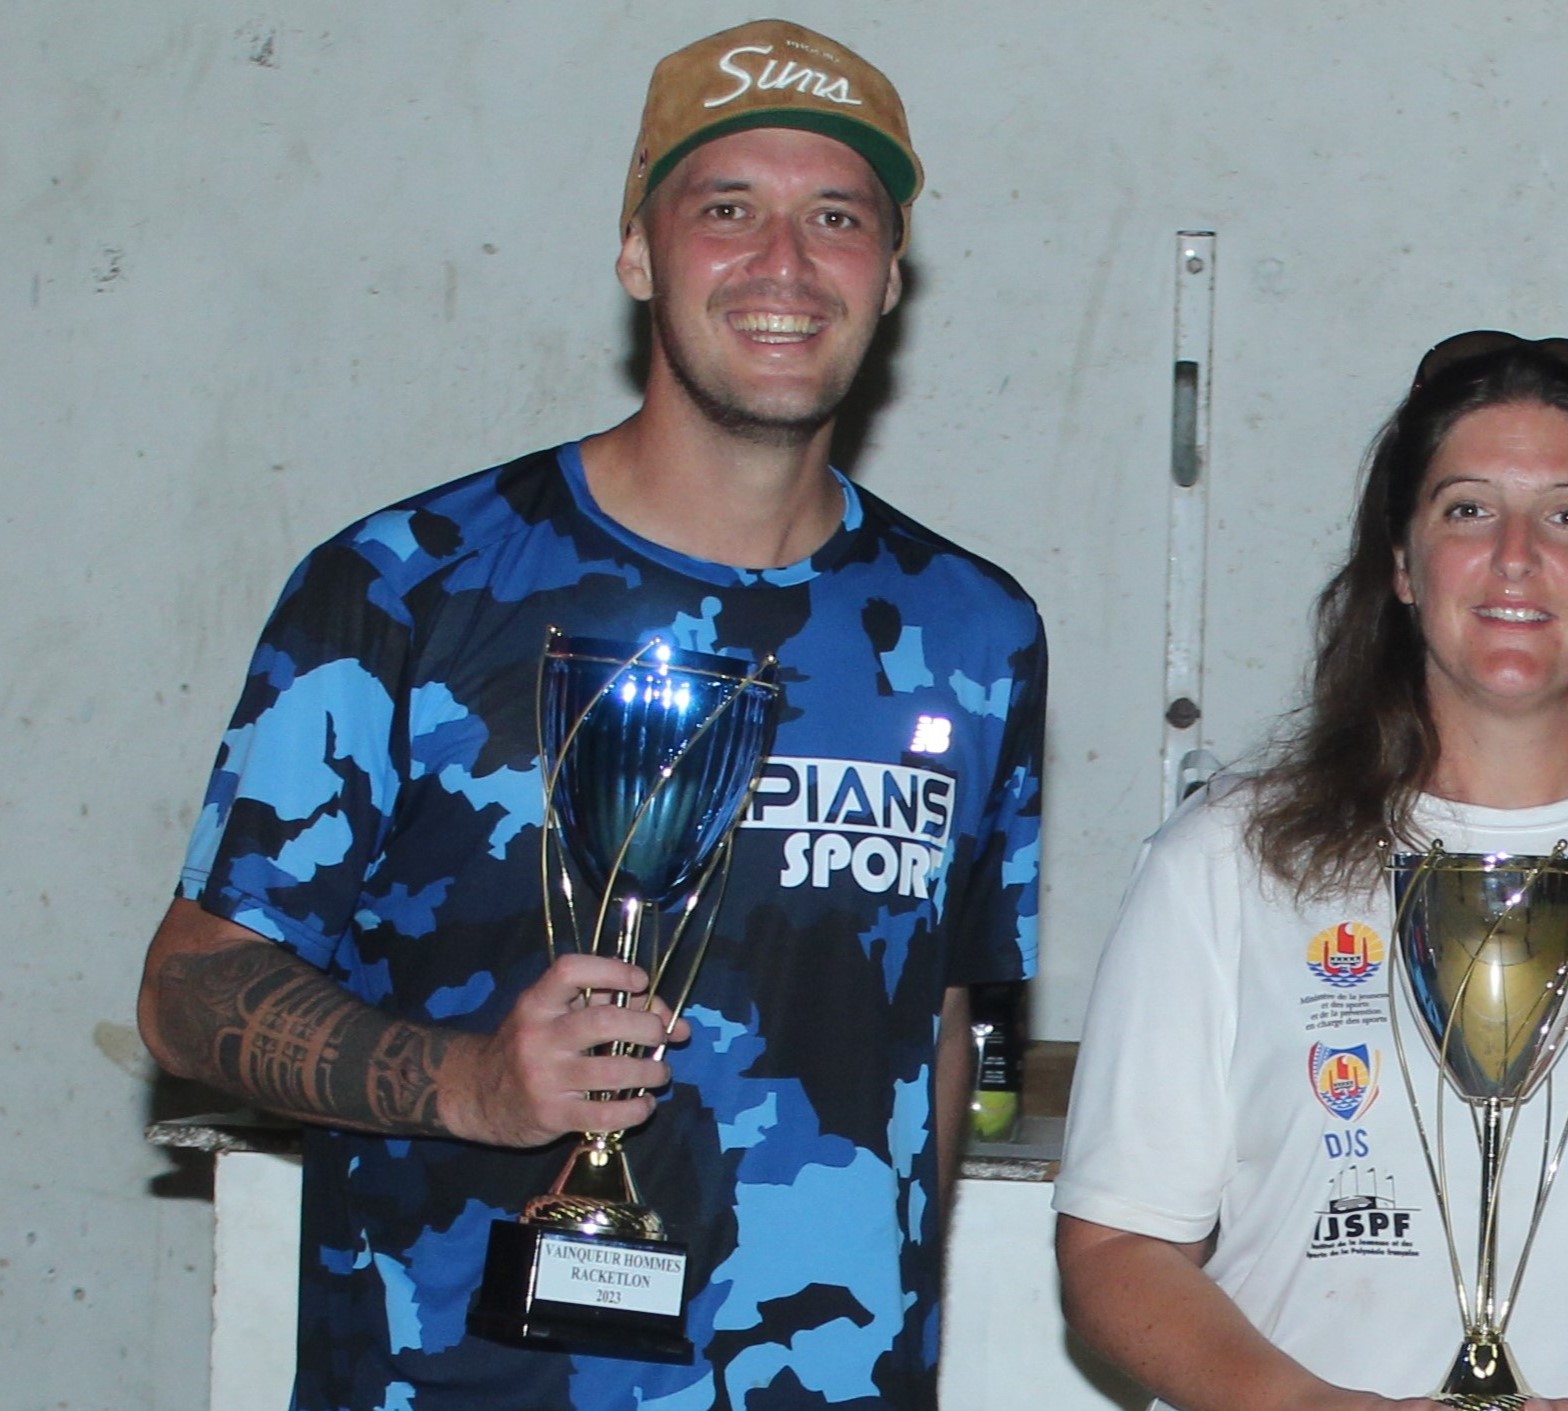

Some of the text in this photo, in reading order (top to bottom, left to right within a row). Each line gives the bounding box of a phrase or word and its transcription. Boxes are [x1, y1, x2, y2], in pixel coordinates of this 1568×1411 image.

[704, 45, 863, 108] Suns
[741, 763, 949, 839] PIANS
[1324, 1129, 1369, 1159] DJS
[546, 1243, 682, 1273] VAINQUEUR HOMMES
[571, 1266, 651, 1288] RACKETLON
[596, 1289, 622, 1304] 2023
